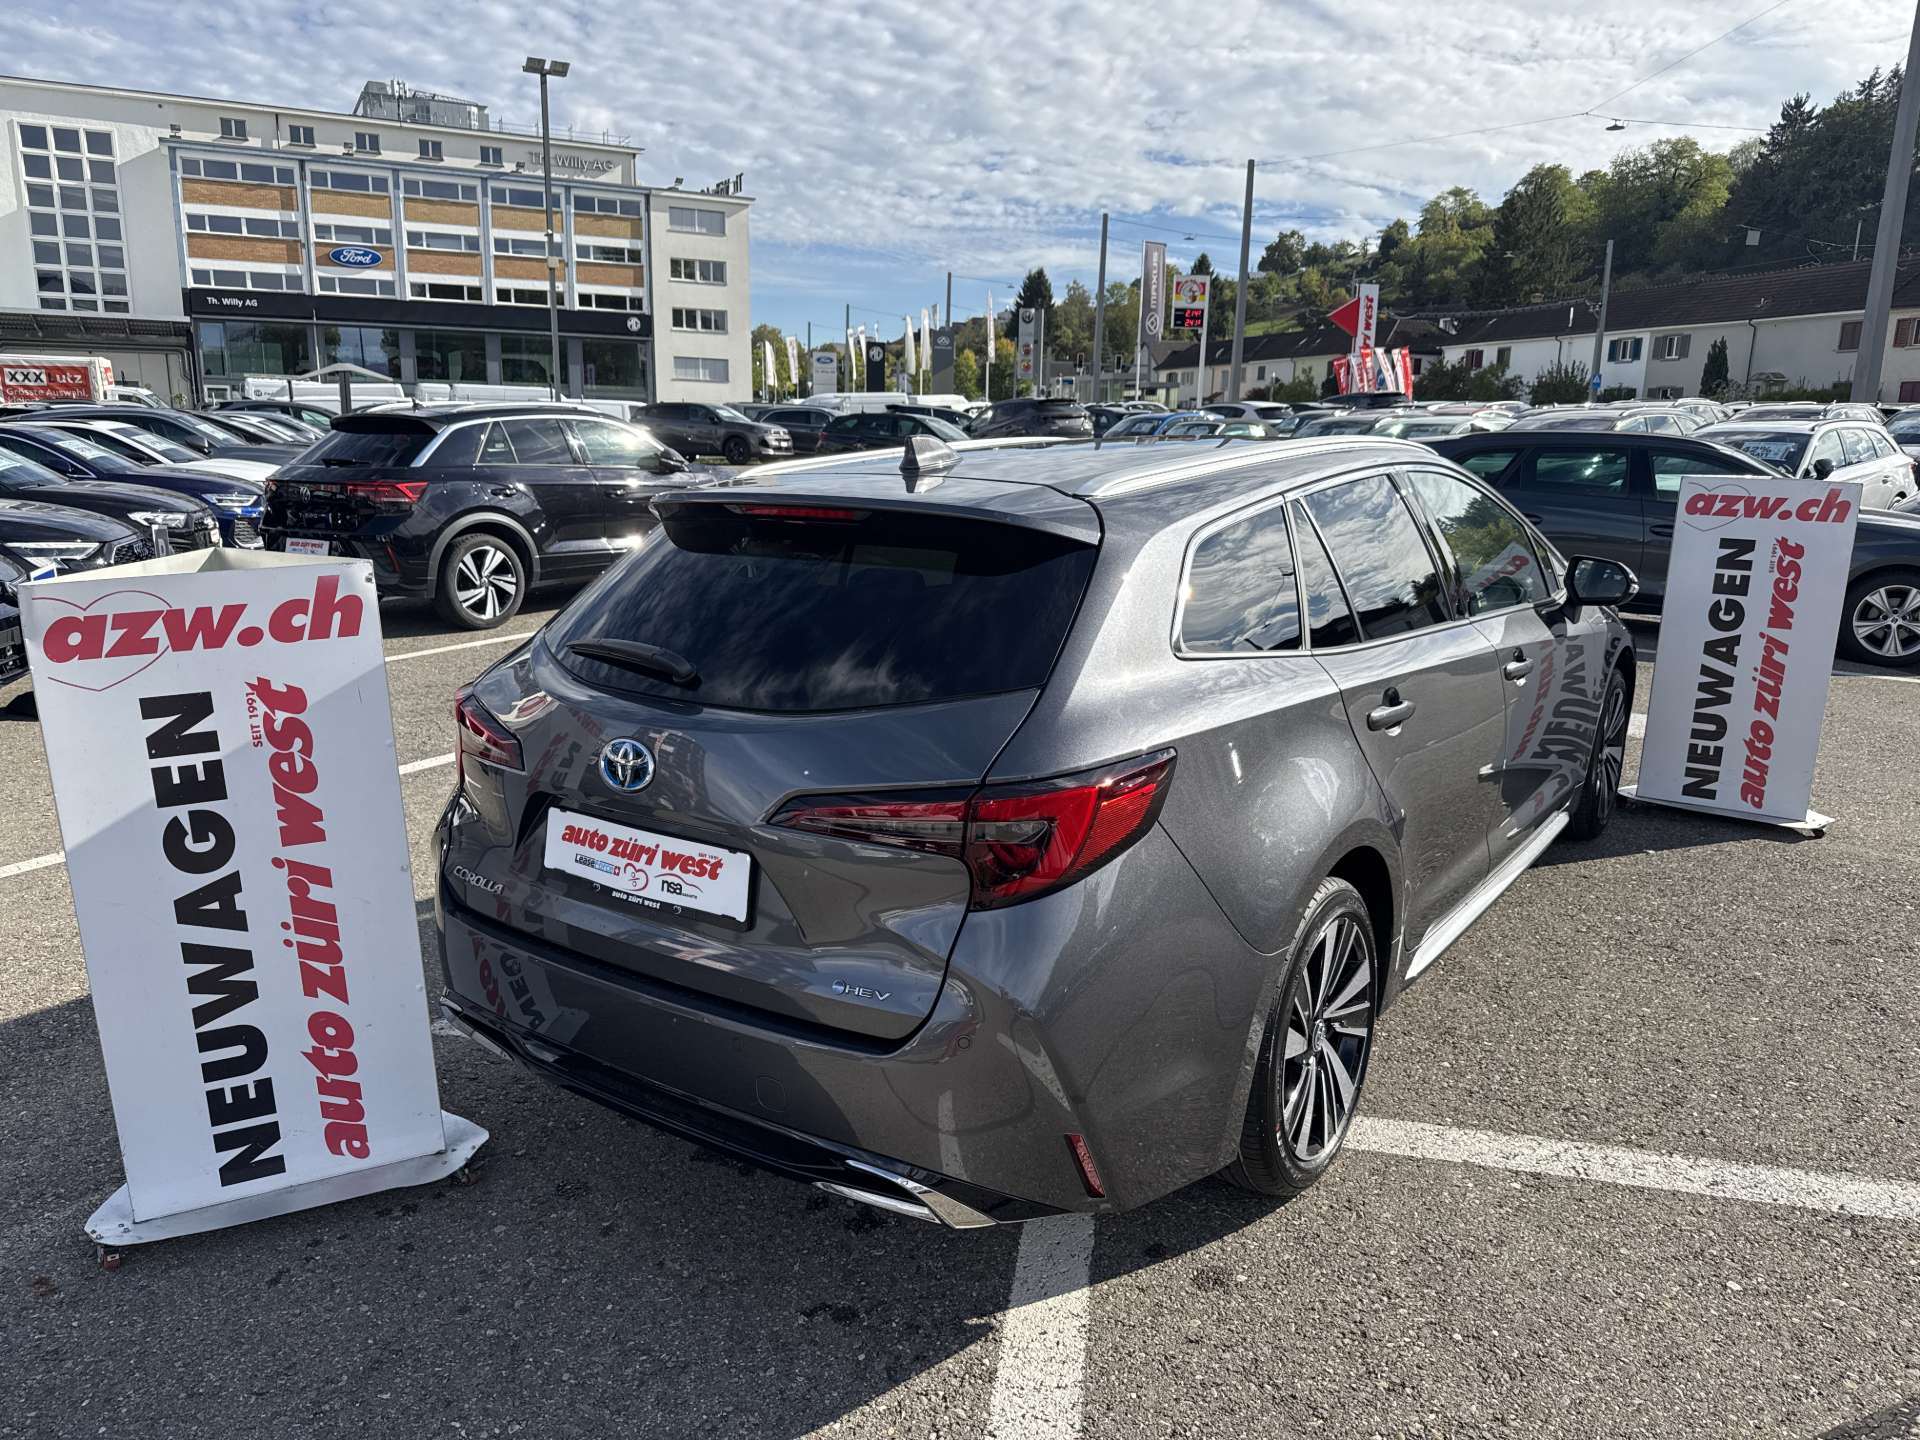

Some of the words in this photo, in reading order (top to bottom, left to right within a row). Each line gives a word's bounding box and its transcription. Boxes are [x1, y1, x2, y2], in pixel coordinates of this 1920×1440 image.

[555, 152, 591, 172] Willy
[592, 159, 614, 171] AG
[339, 248, 373, 264] Ford
[1150, 251, 1160, 309] MAXUS
[206, 296, 220, 305] Th.
[222, 297, 243, 308] Willy
[244, 299, 258, 307] AG
[1684, 487, 1852, 524] azw.ch
[1766, 536, 1806, 631] west
[42, 575, 364, 664] azw.ch
[1681, 537, 1757, 801] NEUWAGEN
[1752, 631, 1791, 722] züri
[246, 691, 259, 717] 1991
[244, 676, 327, 847] west
[250, 719, 264, 748] SEIT
[1741, 719, 1775, 810] auto
[453, 865, 504, 894] COROLLA
[561, 824, 609, 853] auto
[608, 836, 660, 866] züri
[660, 848, 724, 881] west
[611, 890, 628, 901] auto
[628, 894, 643, 905] züri
[644, 898, 660, 910] west
[661, 879, 682, 895] nsa
[138, 690, 287, 1188] NEUWAGEN
[270, 856, 350, 1006] züri
[845, 984, 892, 1001] HEV
[301, 1009, 371, 1160] auto
